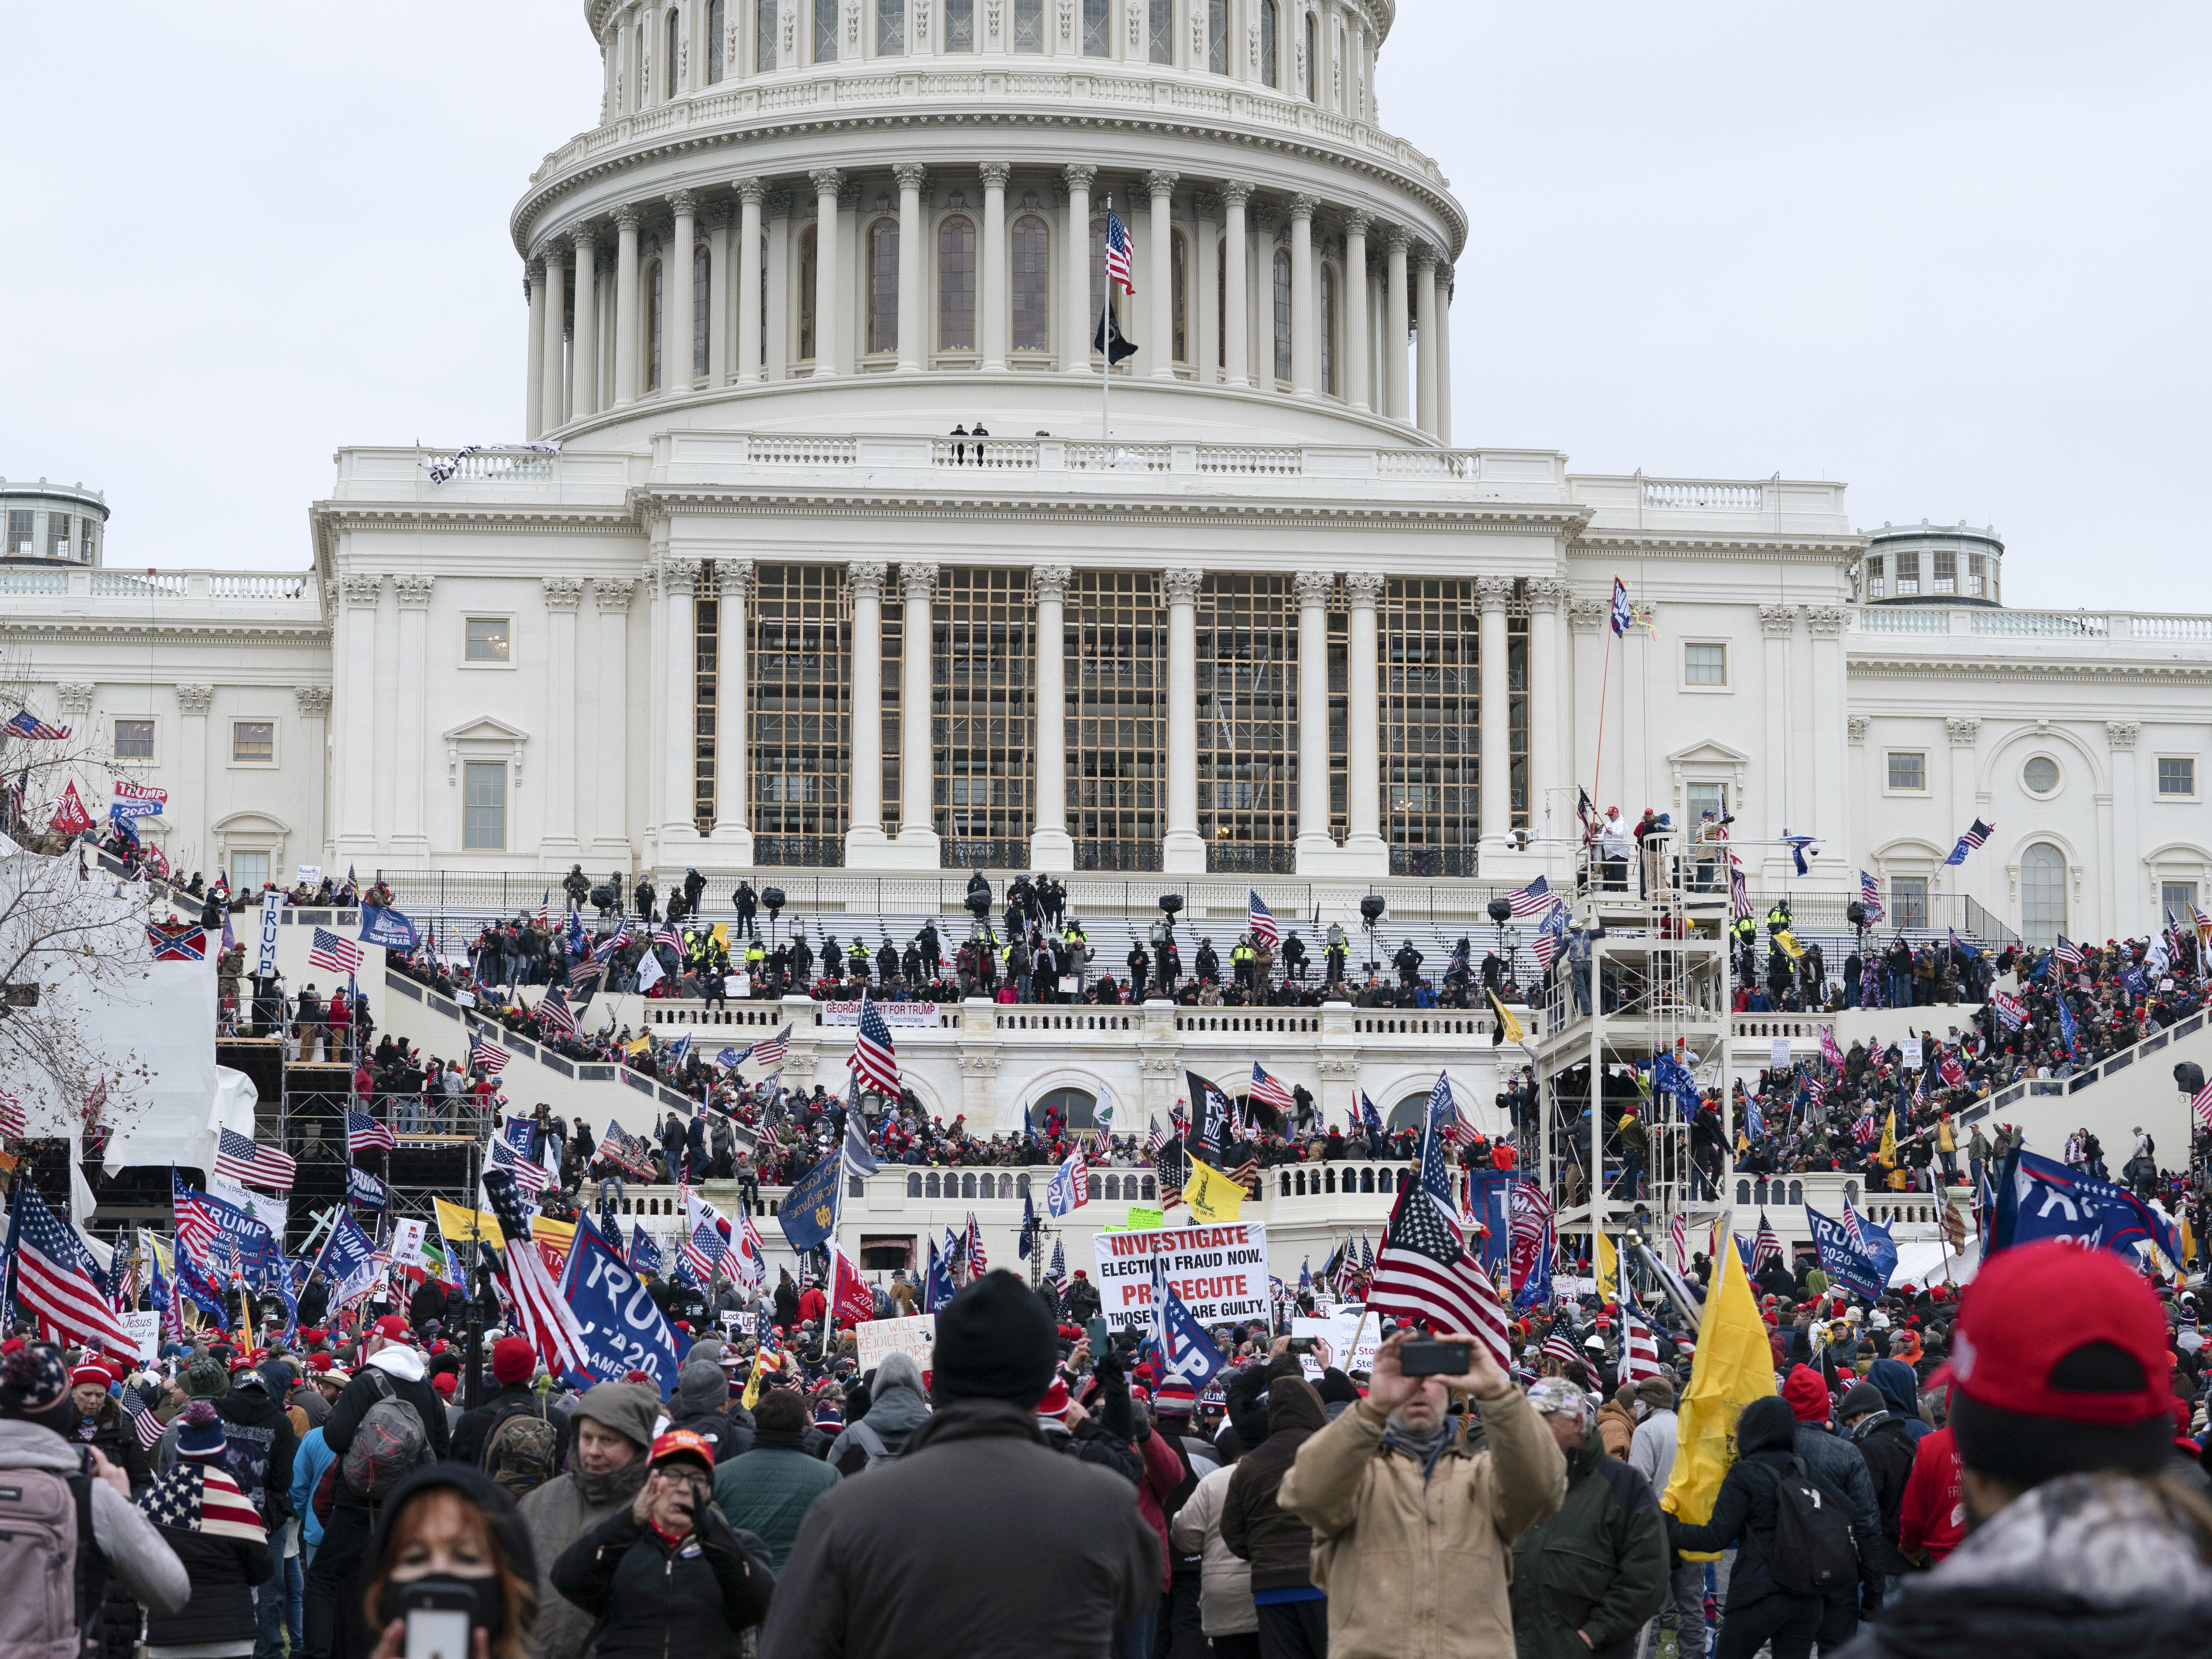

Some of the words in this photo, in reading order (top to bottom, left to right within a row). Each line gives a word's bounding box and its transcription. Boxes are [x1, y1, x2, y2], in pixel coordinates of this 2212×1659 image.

[119, 783, 166, 799] TRUMP
[121, 804, 154, 817] 2020
[259, 895, 279, 975] TRUMP
[369, 933, 388, 943] TRUMP
[826, 1003, 861, 1014] GEORGIA
[889, 1005, 906, 1014] FOR
[908, 1005, 935, 1015] TRUMP
[1998, 992, 2028, 1017] TRUMP
[1943, 1059, 1958, 1070] TRU
[1204, 1117, 1220, 1140] BID
[516, 1126, 530, 1159] TRU
[1072, 1150, 1087, 1201] RUMP
[217, 1180, 225, 1189] AN
[254, 1193, 262, 1202] TO
[199, 1201, 267, 1238] TRUMP
[1110, 1225, 1249, 1256] INVESTIGATE
[1811, 1214, 1869, 1257] TRUM
[238, 1250, 258, 1258] REAT!
[636, 1258, 649, 1267] KEEP
[1175, 1253, 1222, 1270] FRAUD
[1228, 1248, 1263, 1265] NOW.
[848, 1263, 873, 1294] TRU
[1847, 1270, 1874, 1289] GREAT!
[1122, 1274, 1248, 1306] PRSECUTE
[852, 1292, 874, 1311] -202
[122, 1314, 152, 1329] Jesus
[722, 1311, 740, 1320] Lock
[742, 1316, 755, 1328] UP
[1108, 1309, 1151, 1326] THOSE
[1191, 1304, 1217, 1319] ARE
[1221, 1299, 1266, 1316] GUILTY.
[860, 1321, 881, 1336] YET
[887, 1317, 914, 1332] WILL
[921, 1317, 929, 1327] I
[859, 1334, 900, 1350] REJOICE
[905, 1333, 915, 1343] IN
[861, 1350, 883, 1363] THE
[896, 1344, 933, 1361] ORD
[1521, 1367, 1535, 1375] UMP
[1204, 1391, 1226, 1401] RUM
